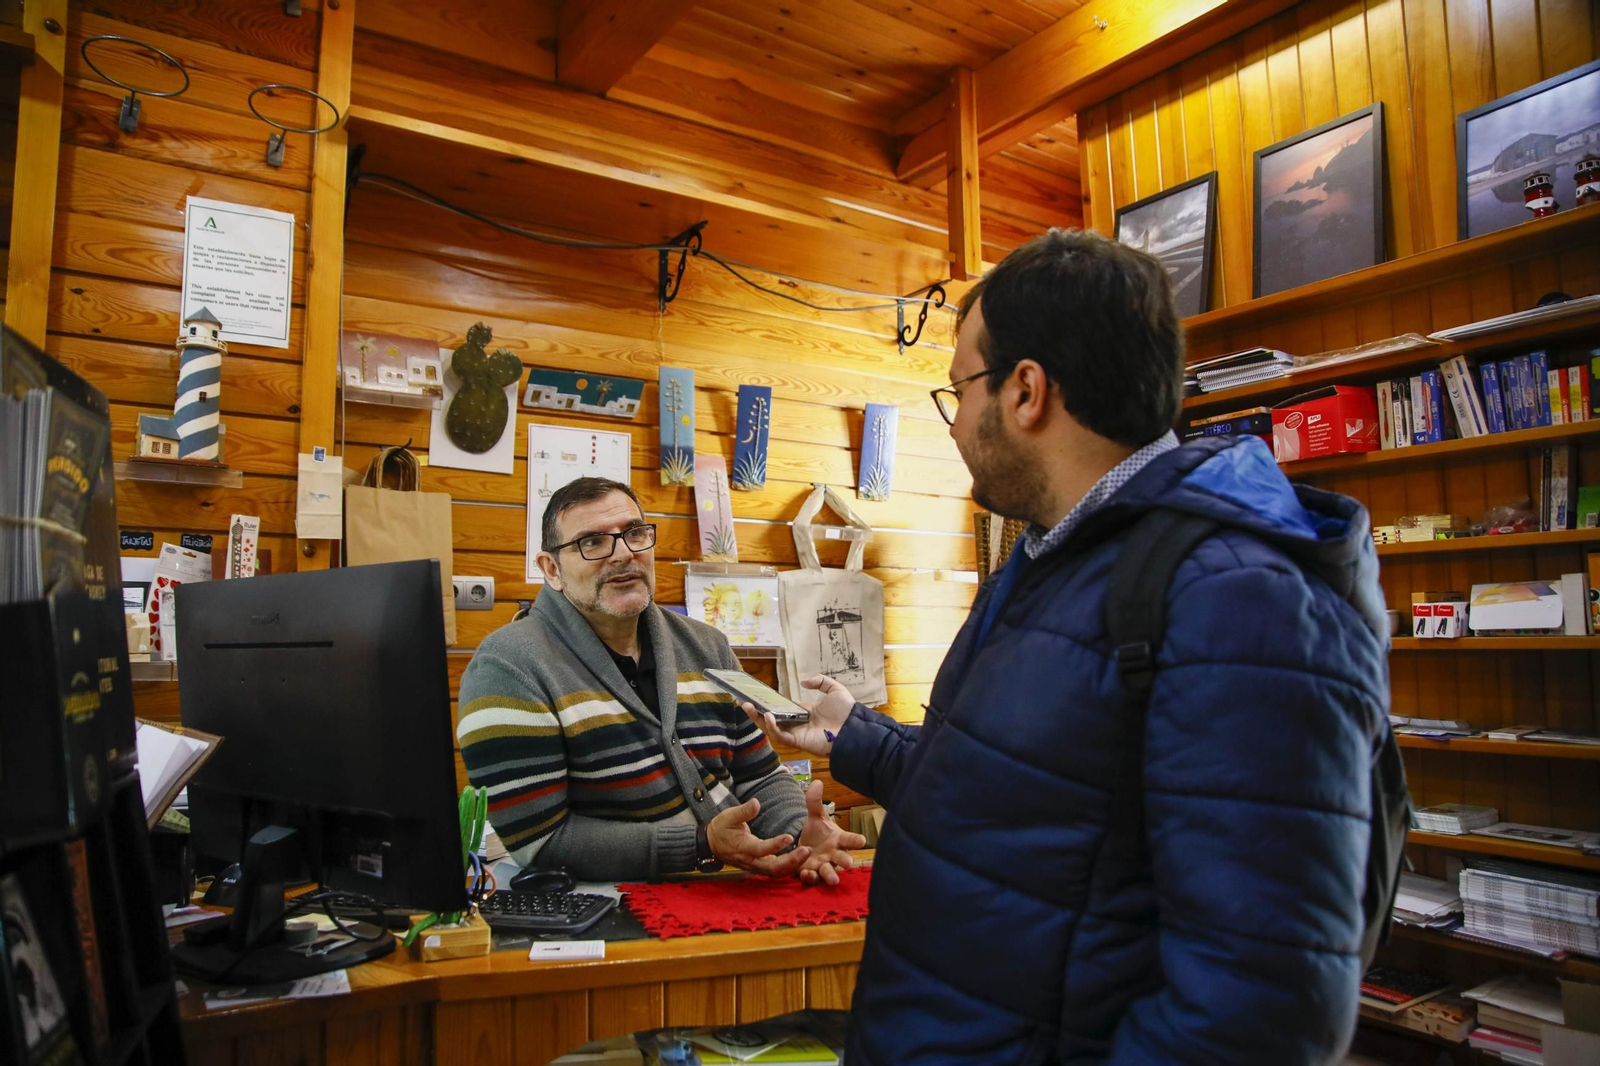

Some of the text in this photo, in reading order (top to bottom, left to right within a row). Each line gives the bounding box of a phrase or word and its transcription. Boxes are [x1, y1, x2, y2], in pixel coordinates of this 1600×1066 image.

[208, 247, 246, 257] establecimiento
[216, 254, 252, 264] reclamaciones
[207, 286, 240, 294] establishment
[1205, 423, 1231, 436] ETÉREO
[122, 536, 152, 545] TARJETAS
